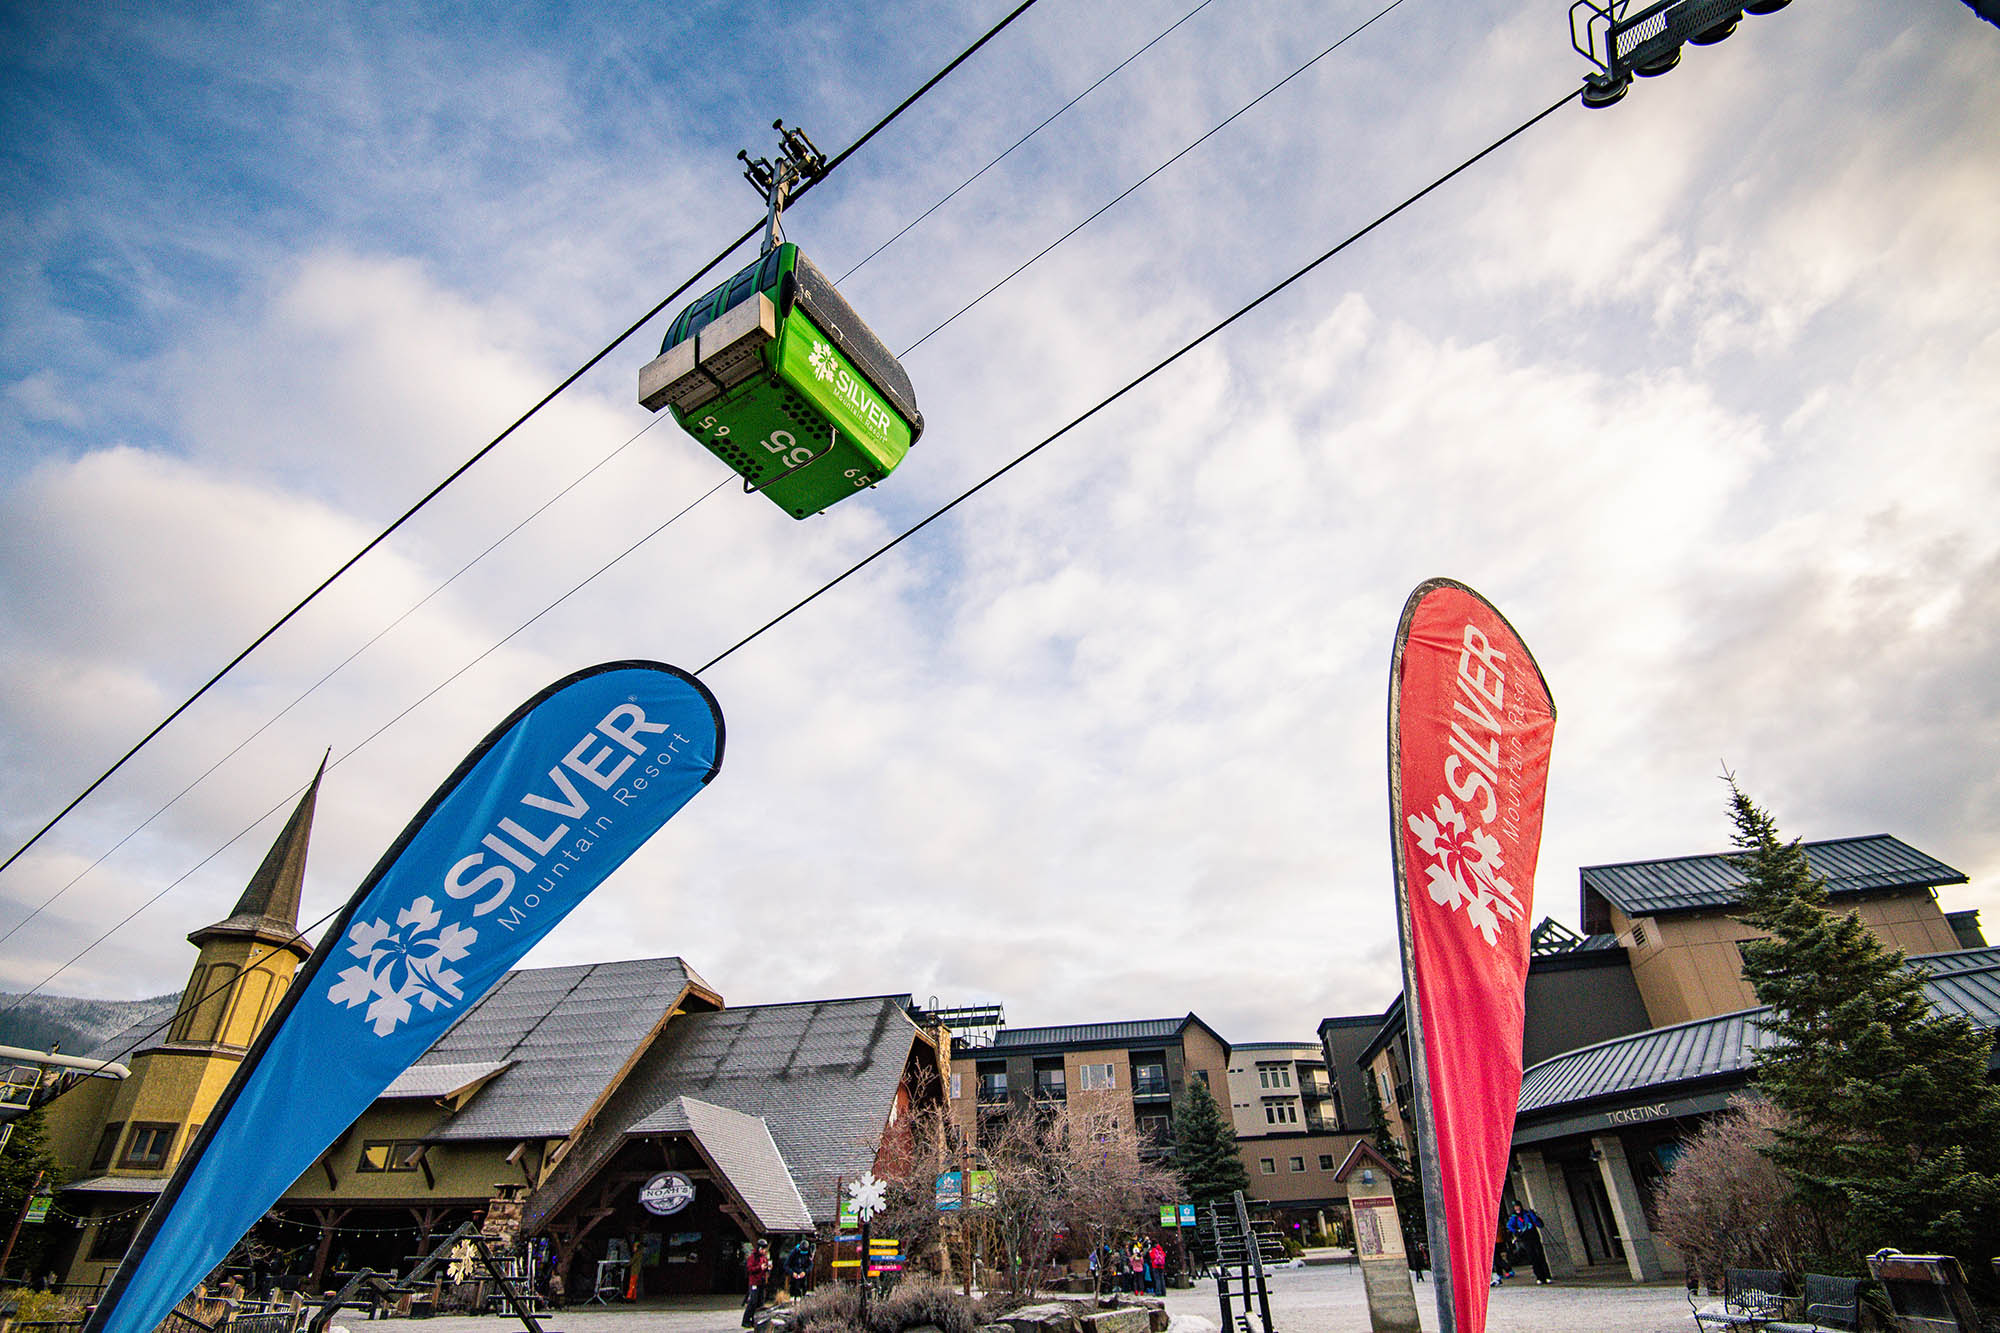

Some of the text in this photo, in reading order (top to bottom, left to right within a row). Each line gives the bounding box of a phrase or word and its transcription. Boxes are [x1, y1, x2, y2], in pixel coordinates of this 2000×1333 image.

[698, 415, 731, 437] 65
[833, 387, 887, 443] Mountain Resort
[836, 370, 890, 435] SILVER
[760, 430, 814, 468] 65
[844, 469, 871, 487] 65
[1444, 624, 1507, 824] SILVER
[1502, 667, 1526, 843] Mountain Resort
[443, 703, 670, 918] SILVER
[496, 732, 690, 931] Mountain Resort
[1605, 1103, 1669, 1125] TICKETING
[646, 1187, 689, 1197] NOAH'S
